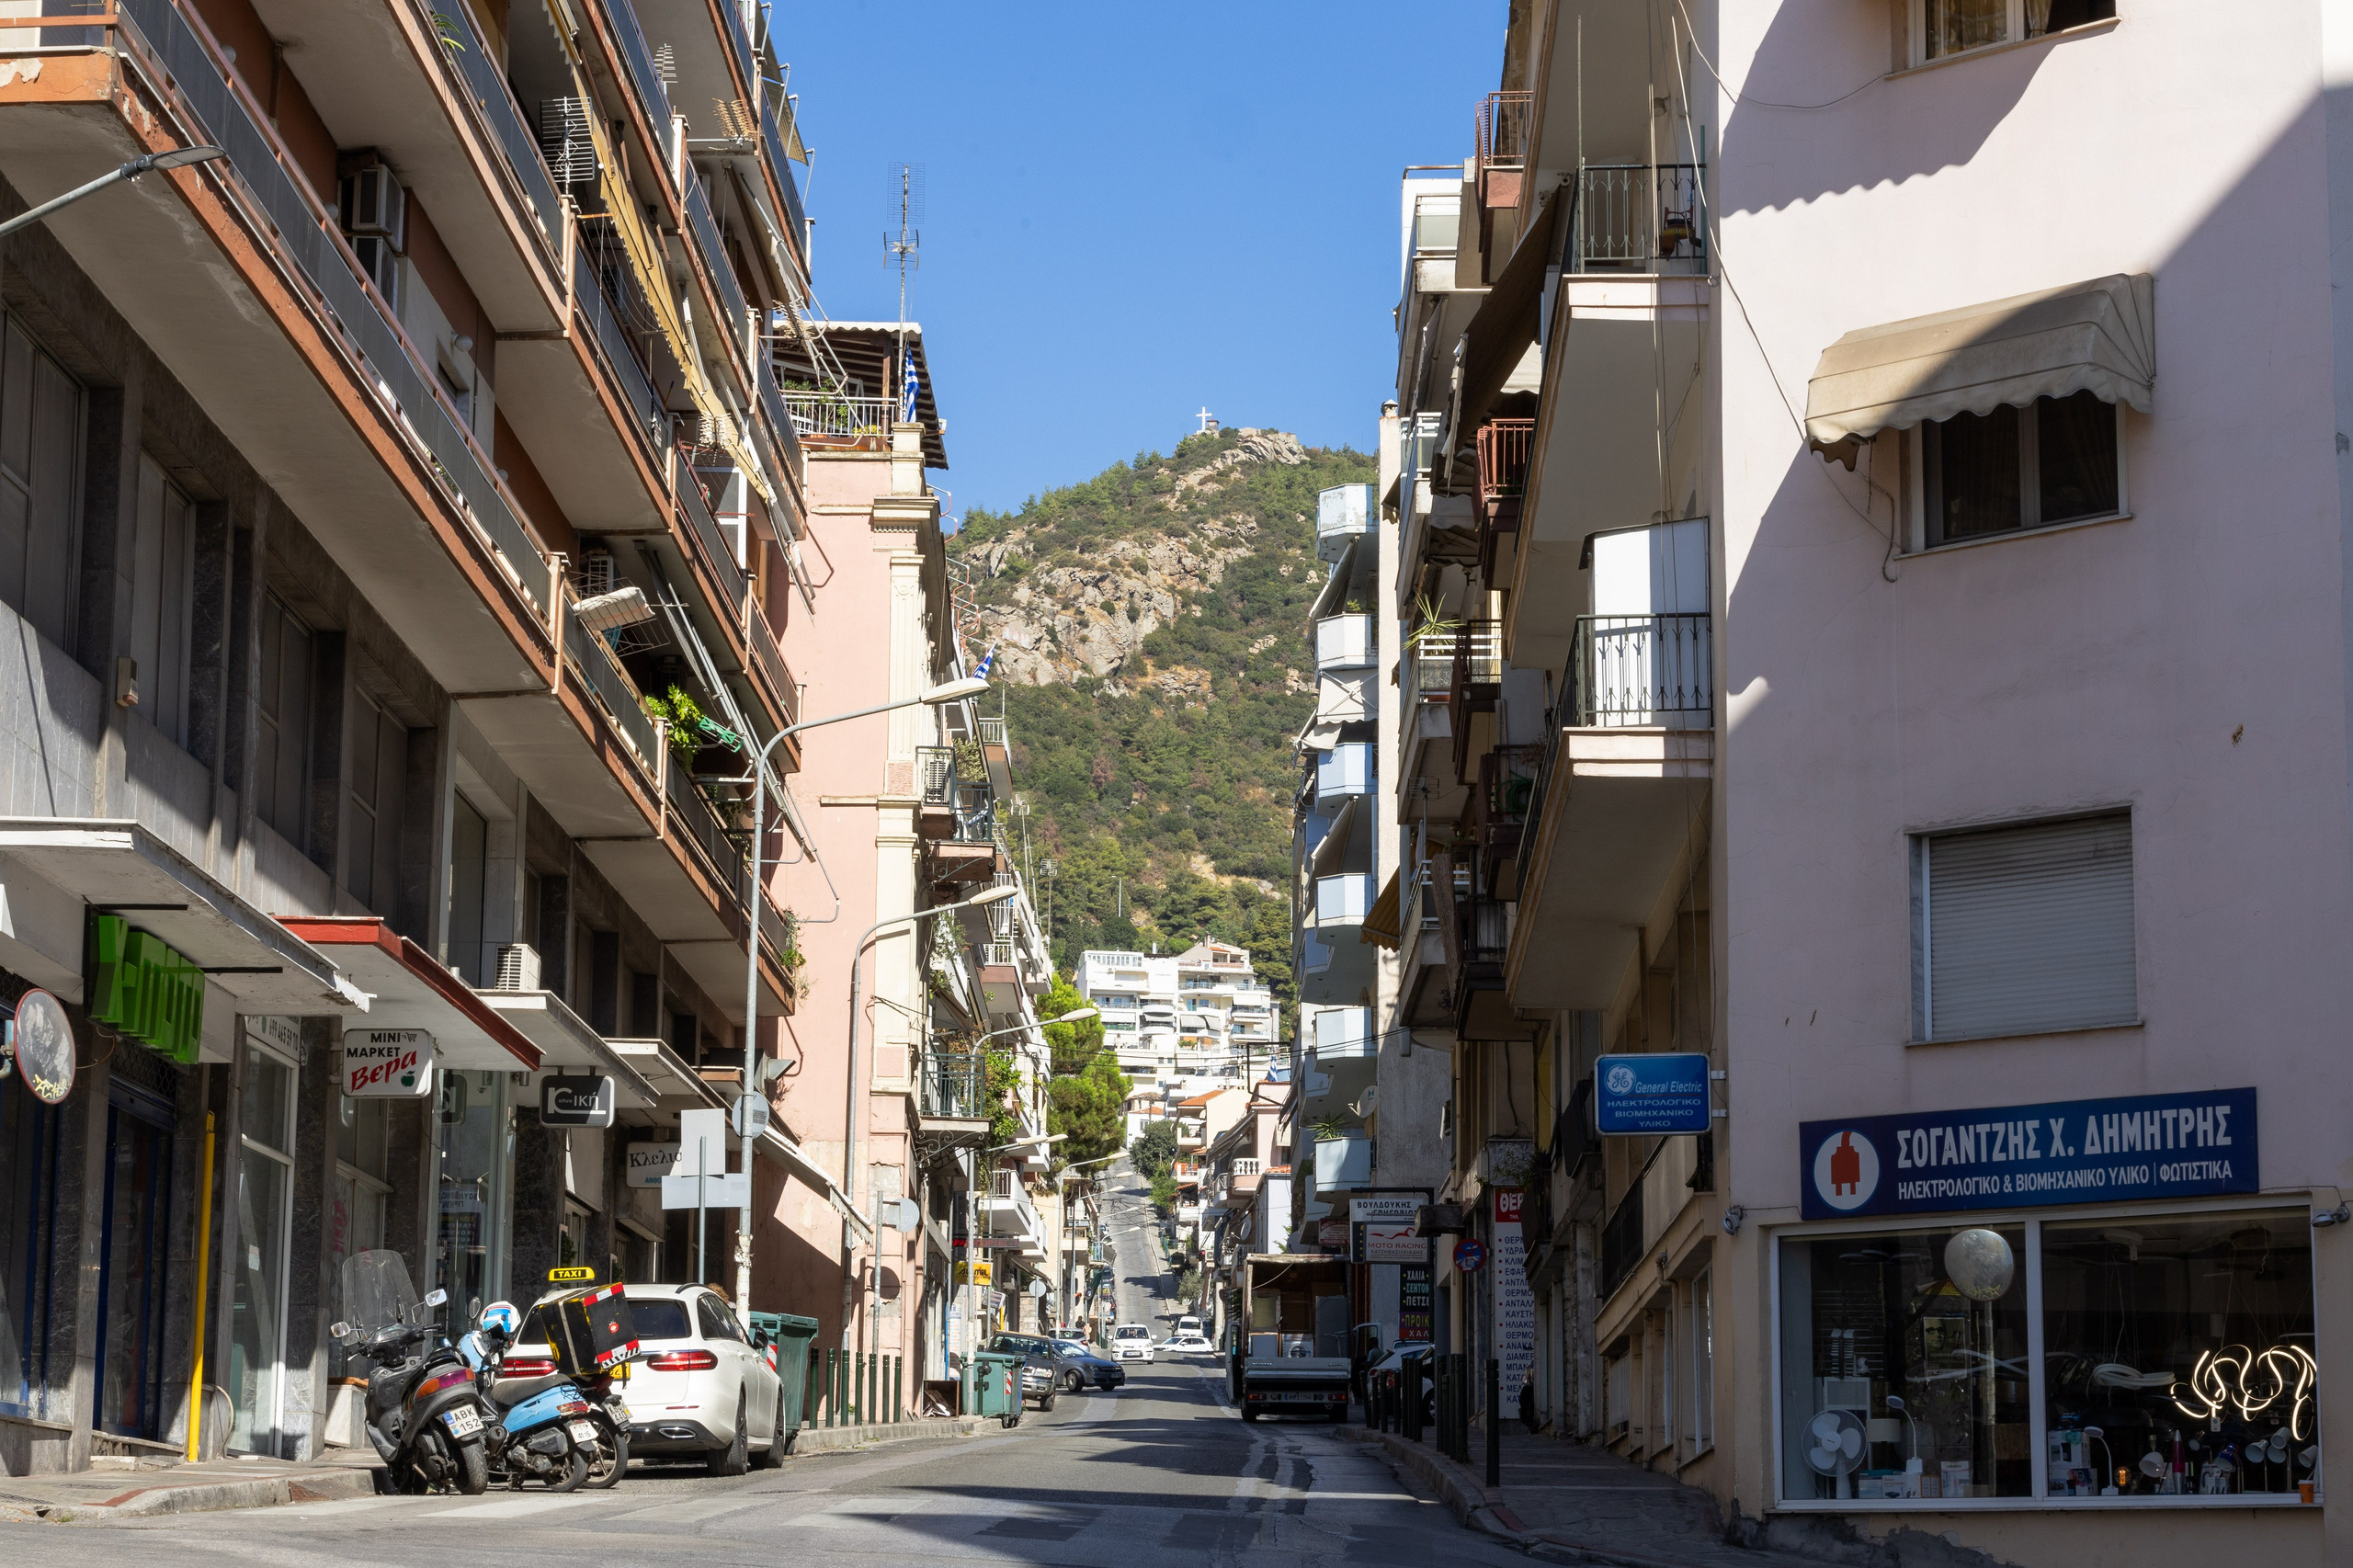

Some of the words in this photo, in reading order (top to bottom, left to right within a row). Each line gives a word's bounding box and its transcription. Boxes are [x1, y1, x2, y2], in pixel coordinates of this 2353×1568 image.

[370, 1032, 401, 1043] ΜΙΝΙ
[347, 1047, 401, 1058] ΜΑΡΚΕΤ
[351, 1051, 416, 1093] Βερα
[1636, 1081, 1668, 1094] General
[1669, 1081, 1702, 1093] Electric
[1607, 1098, 1701, 1108] ΗΛΕΚΤΡΟΛΟΓΙΚΟ
[1615, 1109, 1694, 1118] ΒΙΟΜΗΧΑΝΙΚΟ
[1897, 1119, 2041, 1169] ΣΟΓΑΝΤΖΗΣ
[2049, 1118, 2075, 1158] Χ.
[2084, 1105, 2233, 1155] ΔΗΜΗΤΡΗΣ
[1898, 1175, 2000, 1200] ΗΛΕΚΤΡΟΛΟΓΙΚΟ
[2003, 1175, 2013, 1193] &
[2016, 1167, 2106, 1192] ΒΙΟΜΗΧΑΝΙΚΟ
[2108, 1165, 2150, 1187] ΥΛΙΚΟ
[2159, 1160, 2233, 1183] ΦΩΤΙΣΤΙΚΑ
[1406, 1270, 1426, 1280] ΧΑΛΙΑ
[454, 1407, 475, 1422] ABK
[614, 1410, 628, 1422] 440
[460, 1416, 482, 1433] 152
